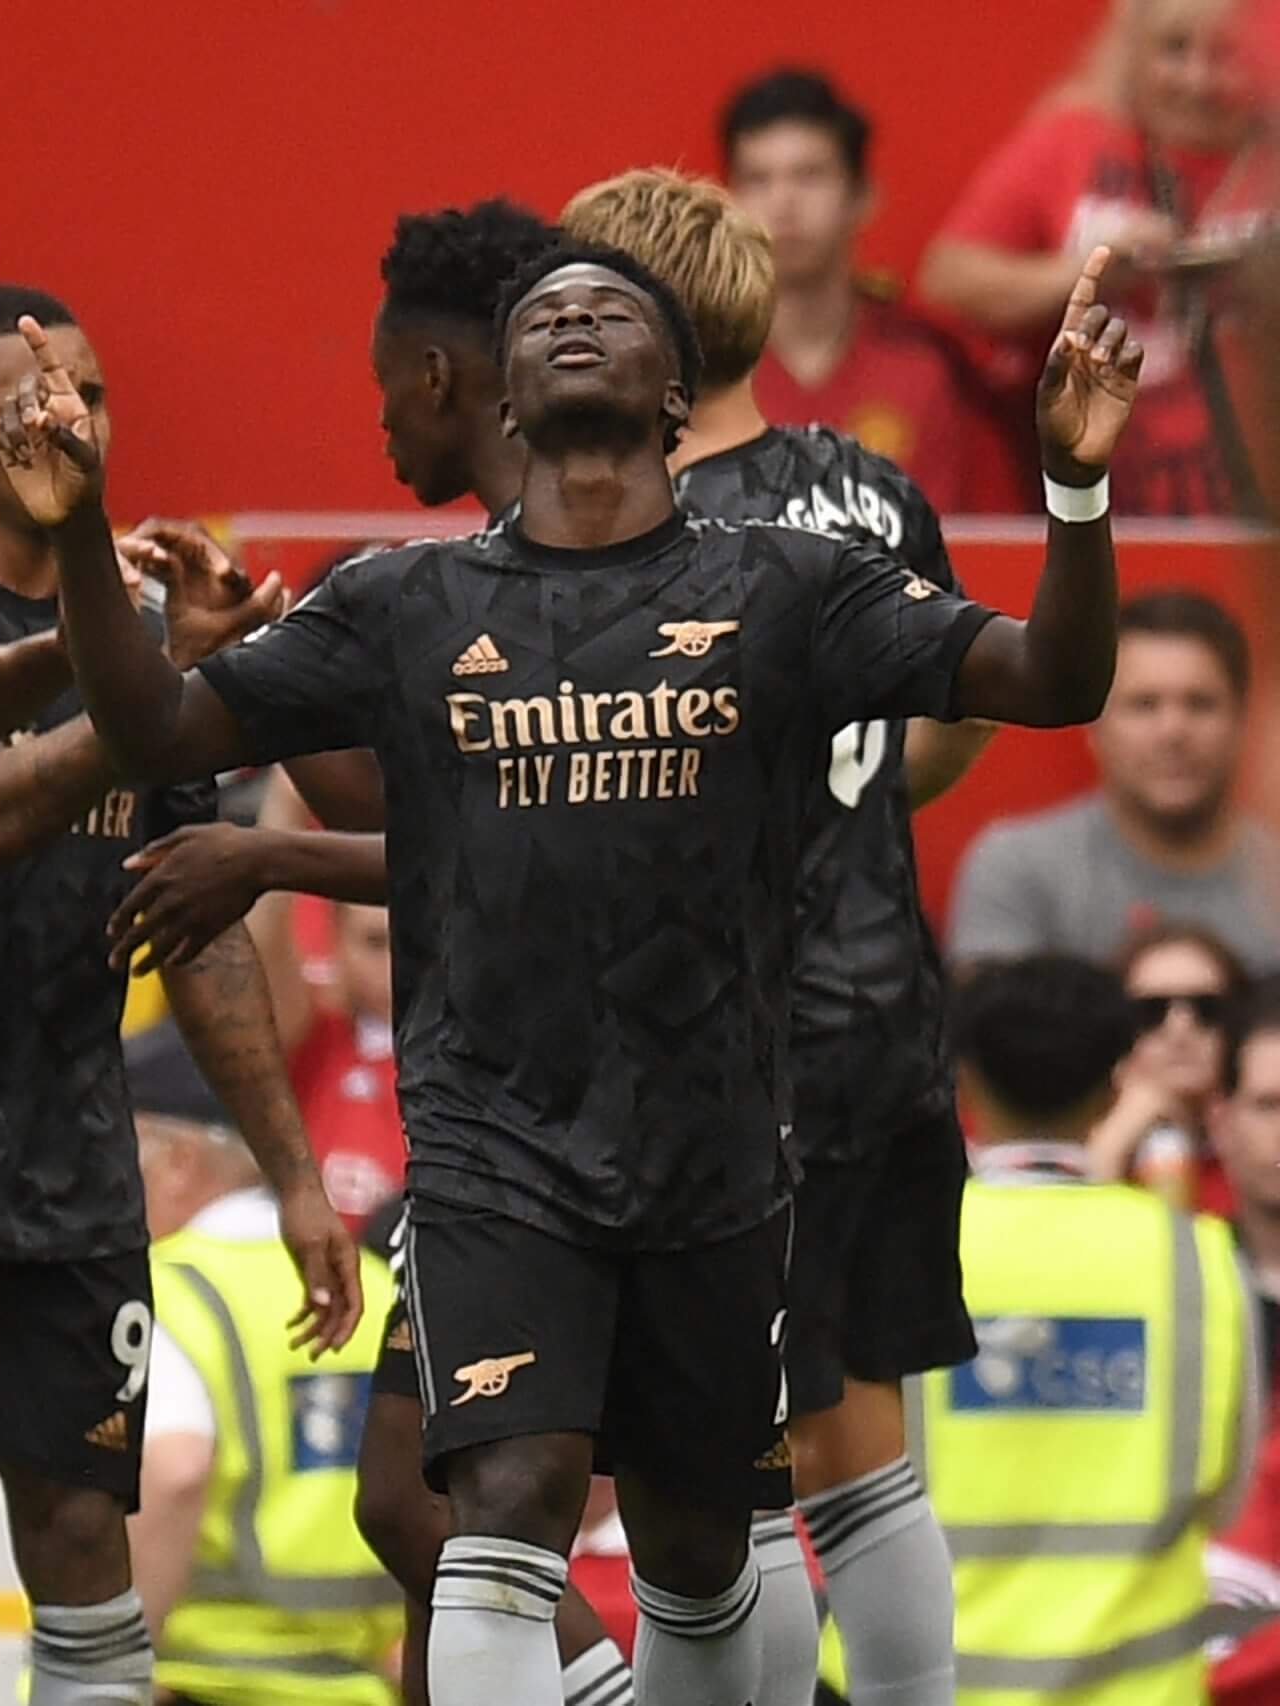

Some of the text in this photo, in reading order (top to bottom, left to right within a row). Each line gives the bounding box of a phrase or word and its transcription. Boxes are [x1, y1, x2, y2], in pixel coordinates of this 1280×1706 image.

[446, 680, 740, 752] Emirates
[497, 748, 701, 808] FLY BETTER
[111, 1300, 153, 1402] 9
